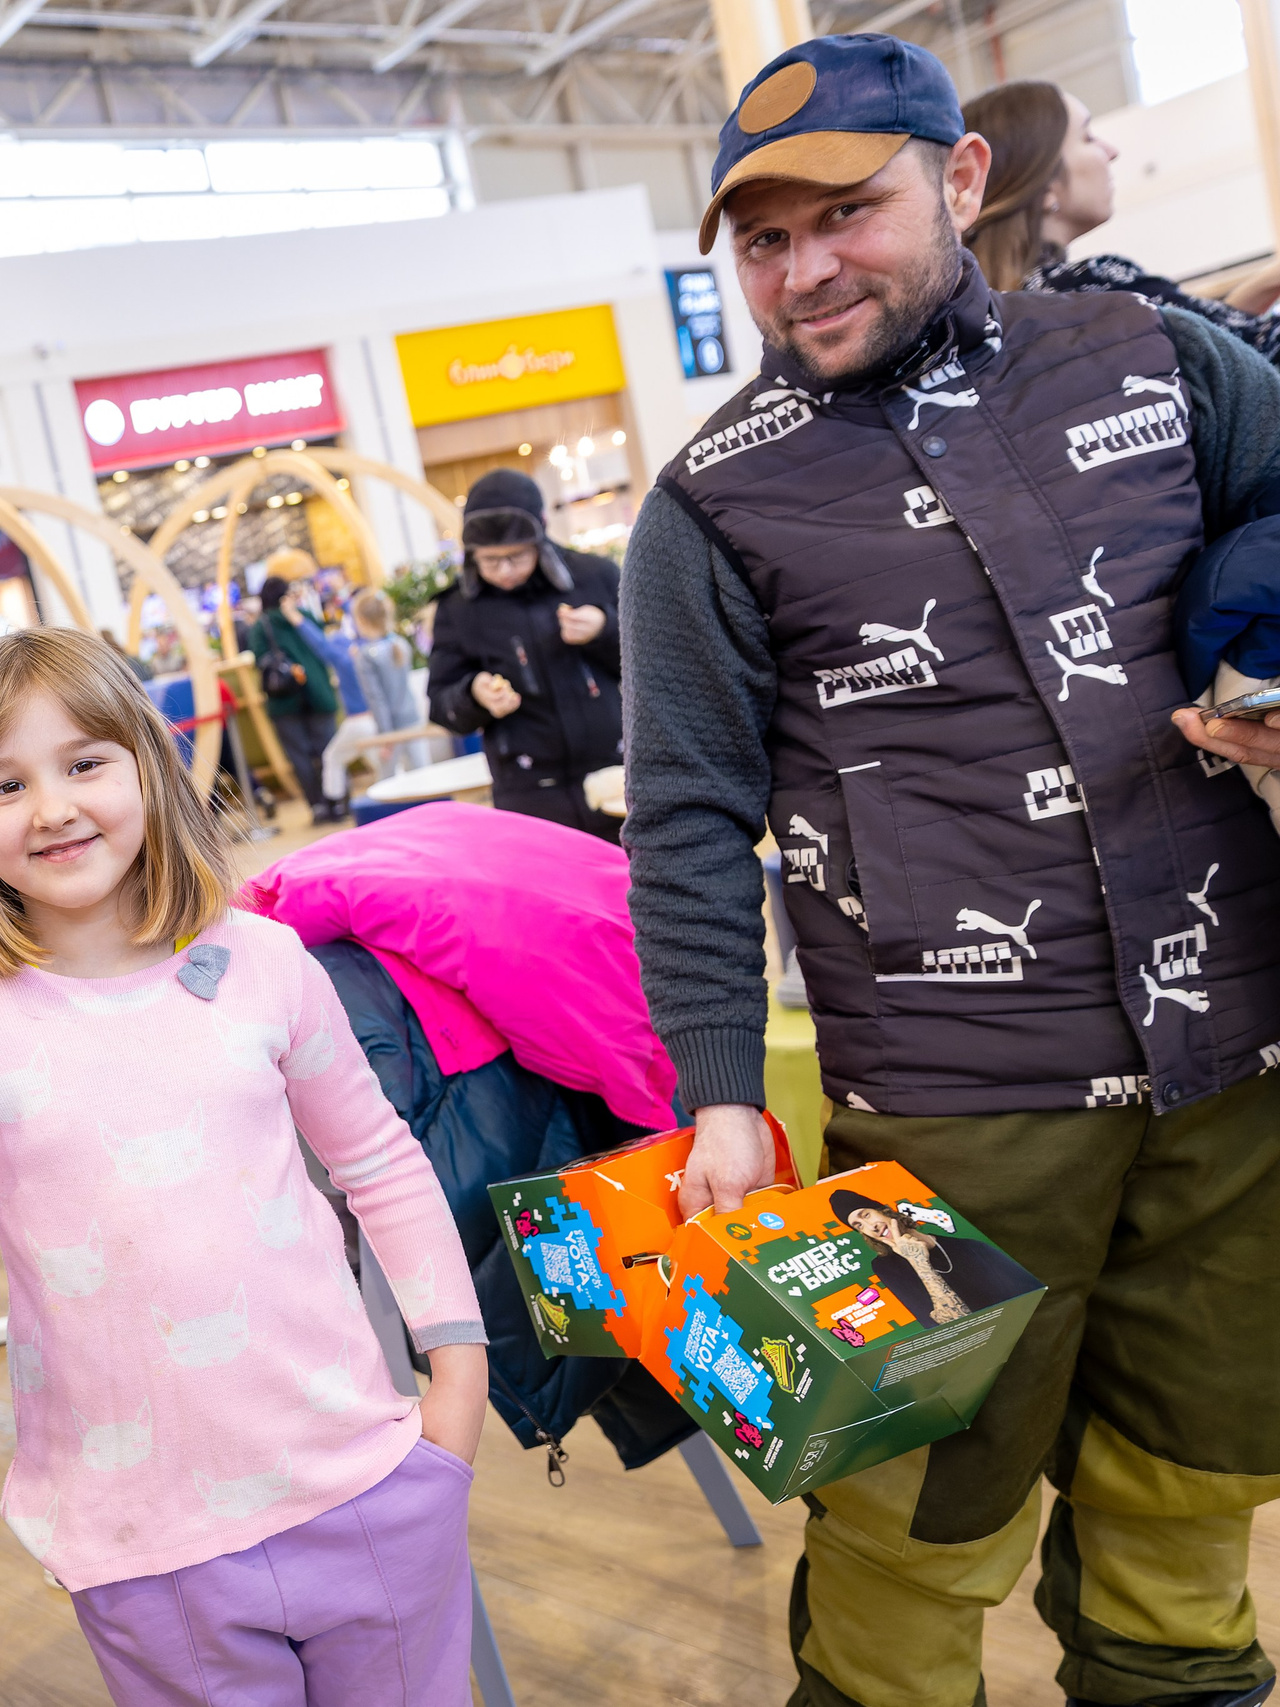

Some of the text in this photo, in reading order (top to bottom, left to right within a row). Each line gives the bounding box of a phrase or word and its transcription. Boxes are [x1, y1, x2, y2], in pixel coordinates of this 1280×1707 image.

[685, 398, 814, 475] PUMA
[1065, 400, 1186, 473] PUMA
[813, 646, 938, 709] PUMA
[565, 1231, 590, 1286] YOTA
[768, 1241, 838, 1284] СУПЕР
[798, 1253, 861, 1291] БОКС
[695, 1326, 720, 1373] YOTA
